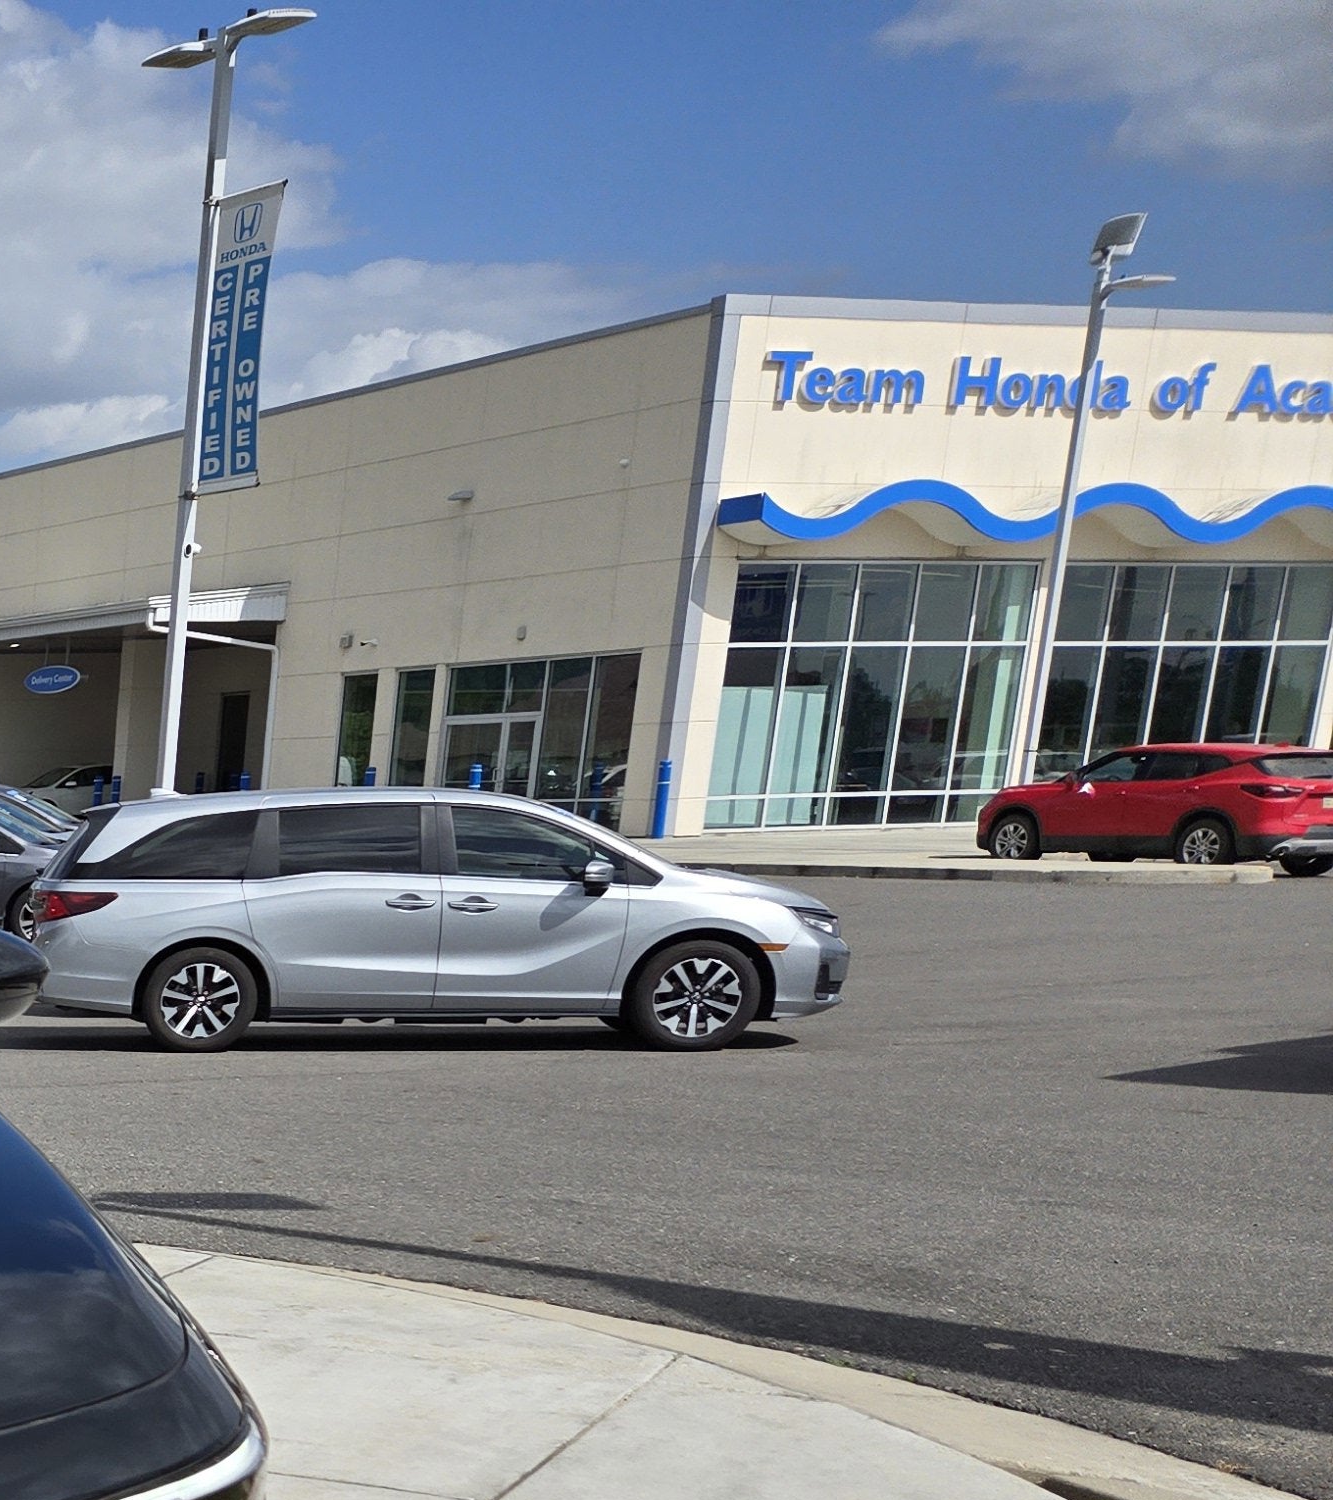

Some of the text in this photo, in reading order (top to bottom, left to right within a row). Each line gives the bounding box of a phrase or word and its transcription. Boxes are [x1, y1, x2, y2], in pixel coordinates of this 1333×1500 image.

[219, 241, 267, 264] HONDA
[202, 271, 234, 477] CERTIFIED
[234, 263, 264, 475] PRE OWNED
[767, 350, 925, 405] Team
[1154, 362, 1218, 412] of
[1232, 363, 1333, 415] Aca
